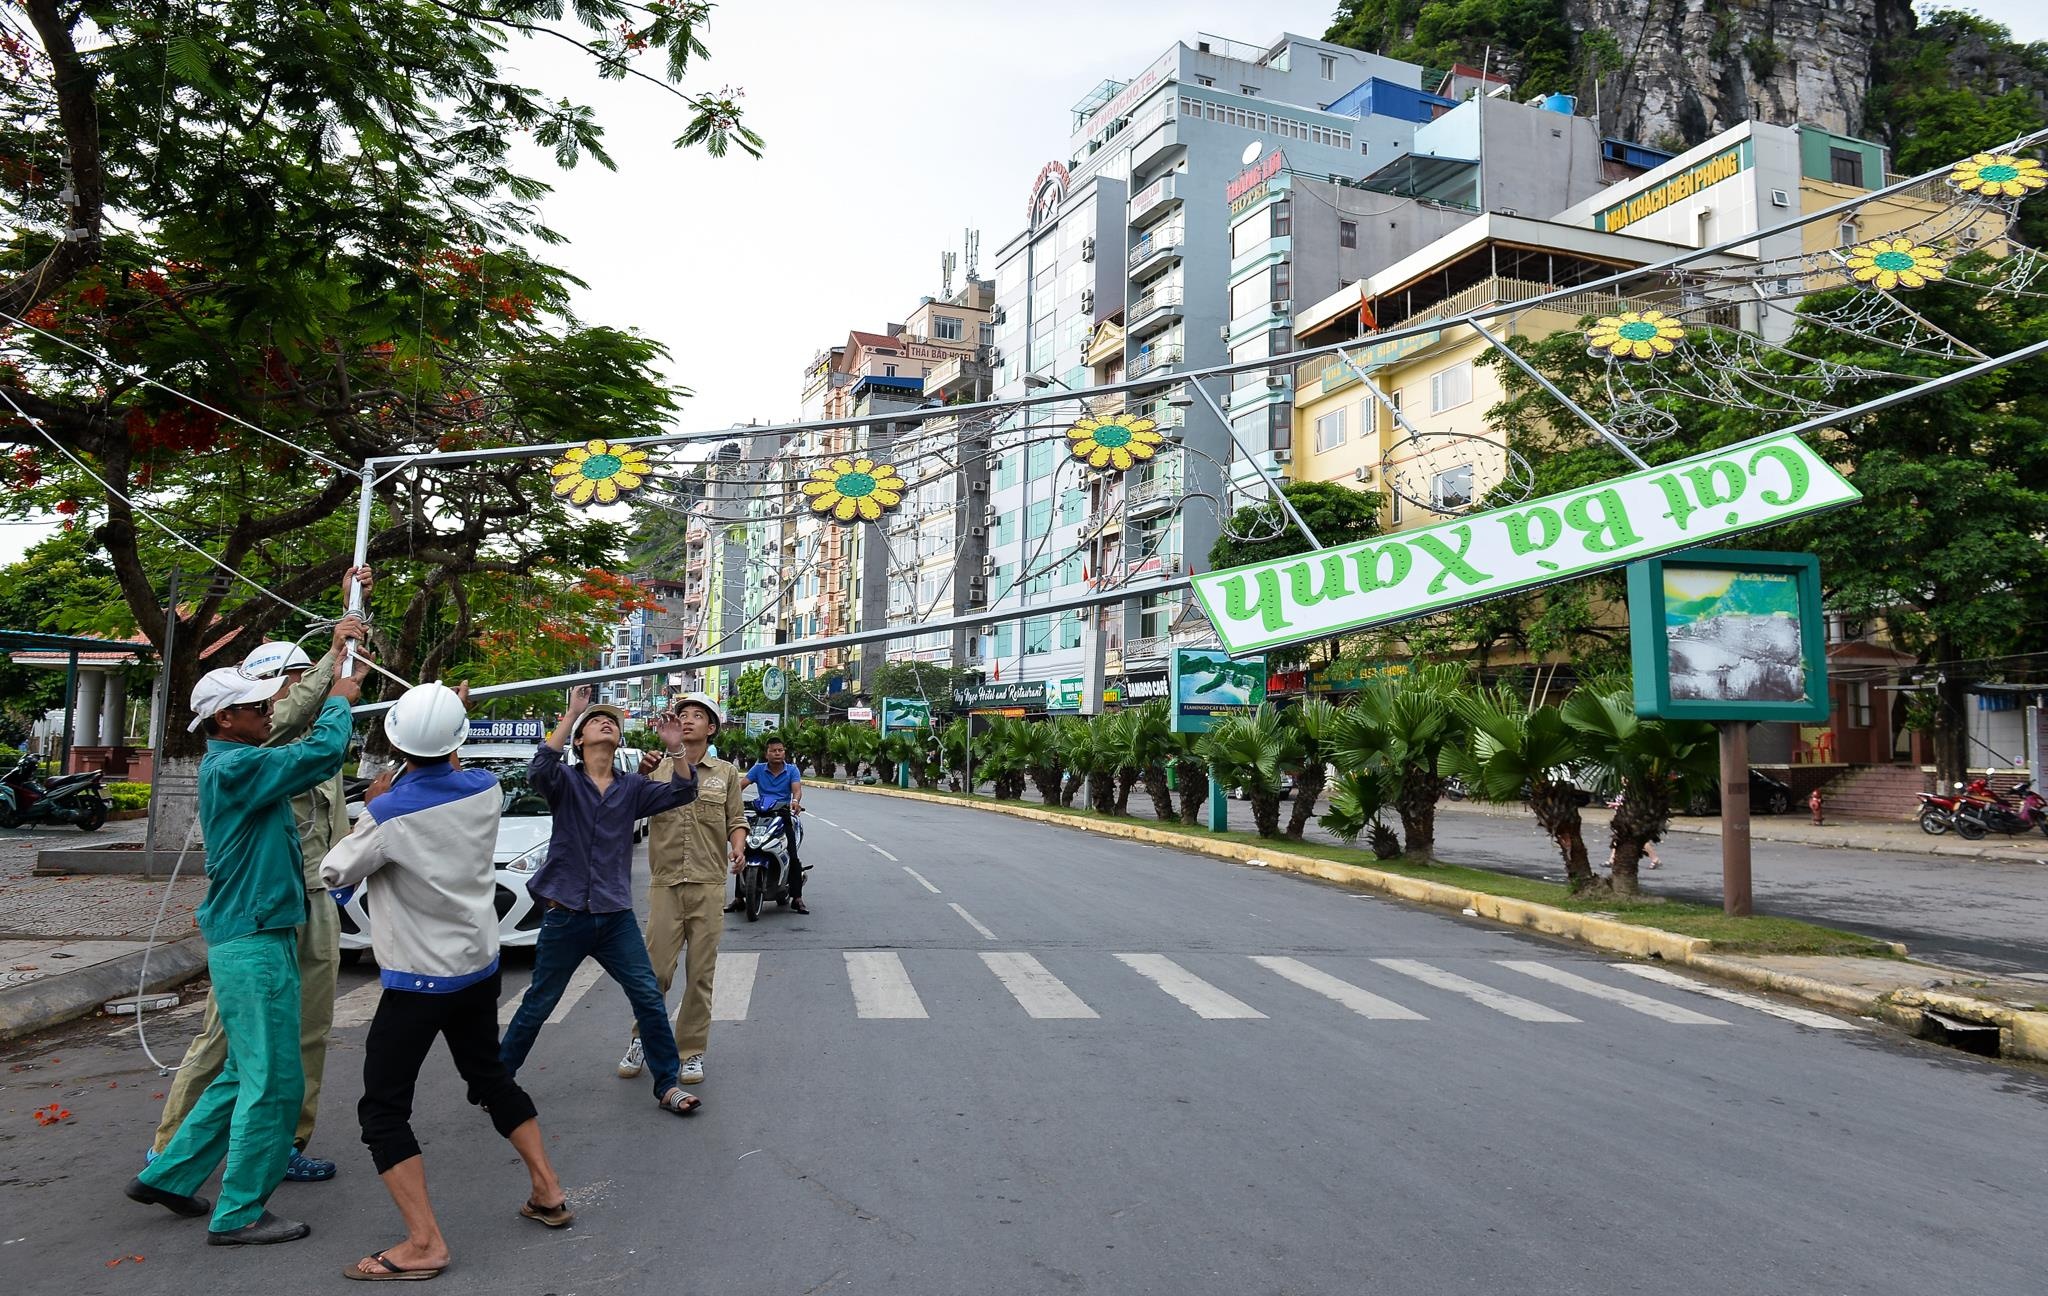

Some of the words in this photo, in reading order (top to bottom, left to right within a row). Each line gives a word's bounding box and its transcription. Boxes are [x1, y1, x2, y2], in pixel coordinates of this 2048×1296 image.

[1231, 180, 1271, 215] HOTEL
[1607, 202, 1628, 231] NHÀ
[1629, 191, 1667, 222] KHÁCH
[1667, 174, 1694, 204] BIÊN
[1694, 153, 1738, 189] PHÒNG
[911, 345, 929, 358] THÁI
[1651, 446, 1809, 529] Cát
[1498, 489, 1643, 571] Bà
[1219, 525, 1493, 632] Xanh
[978, 686, 995, 701] Hotel
[995, 687, 1008, 700] and
[1008, 683, 1044, 701] Restaurant
[1152, 675, 1169, 696] CAFÉ
[468, 723, 513, 736] 02253.688
[515, 723, 537, 736] 699
